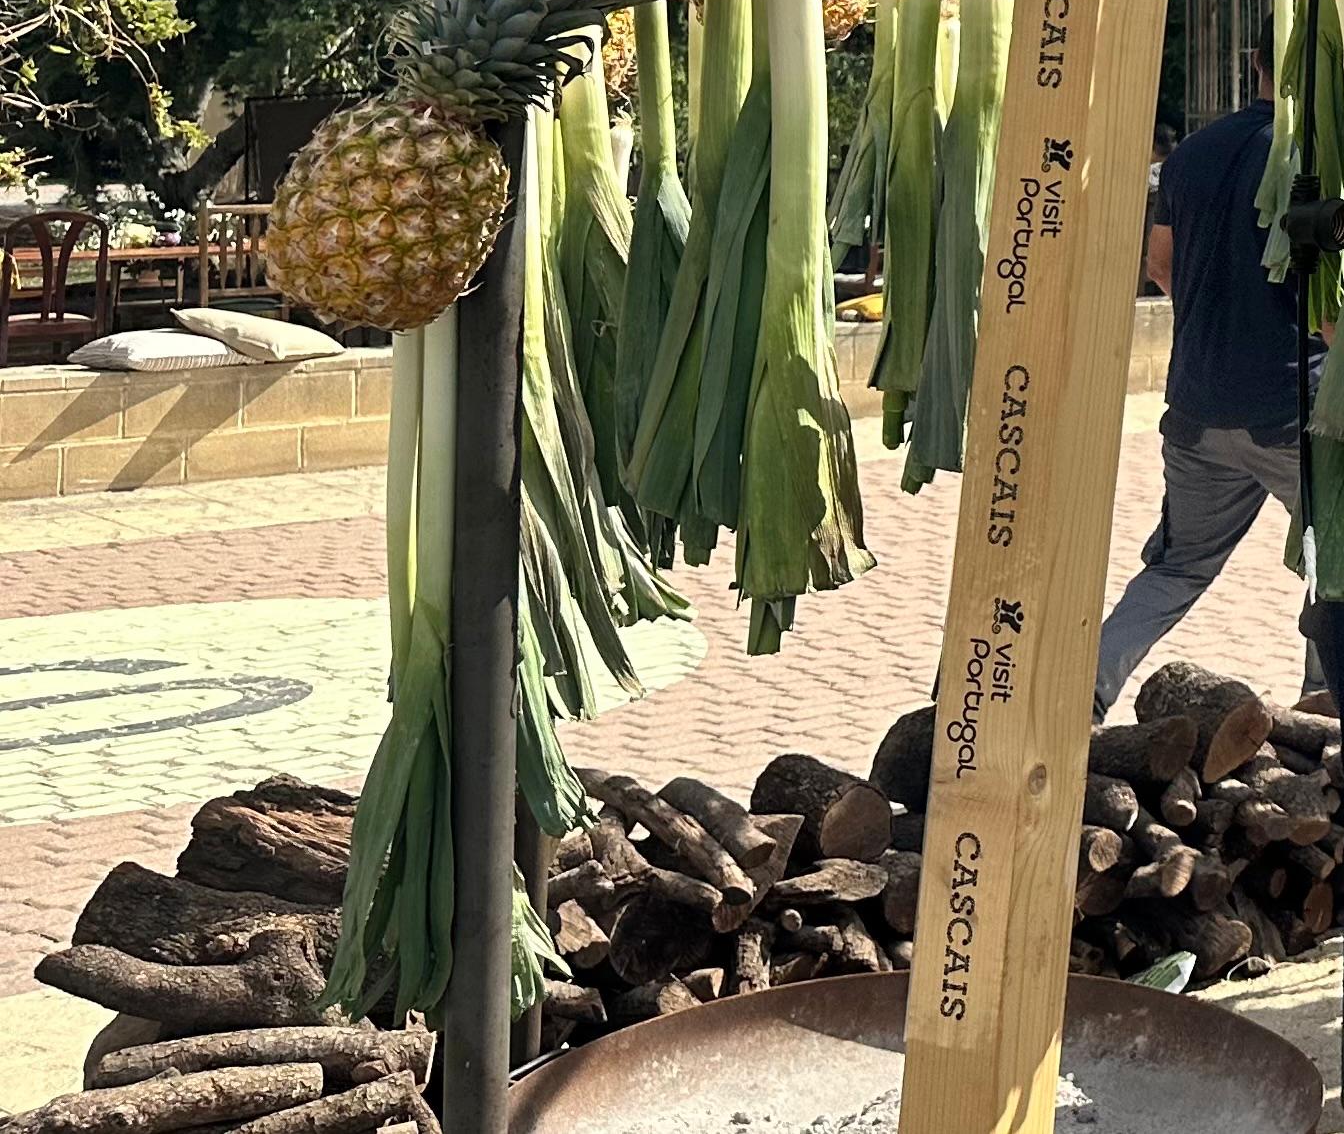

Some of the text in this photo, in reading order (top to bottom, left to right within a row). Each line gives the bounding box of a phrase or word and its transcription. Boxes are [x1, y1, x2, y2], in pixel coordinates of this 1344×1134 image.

[996, 178, 1041, 314] Portugal
[1040, 180, 1065, 238] visit
[988, 365, 1030, 547] CASCAIS
[947, 638, 992, 779] Portugal
[991, 643, 1016, 703] visit
[940, 832, 983, 1021] CASCAIS
